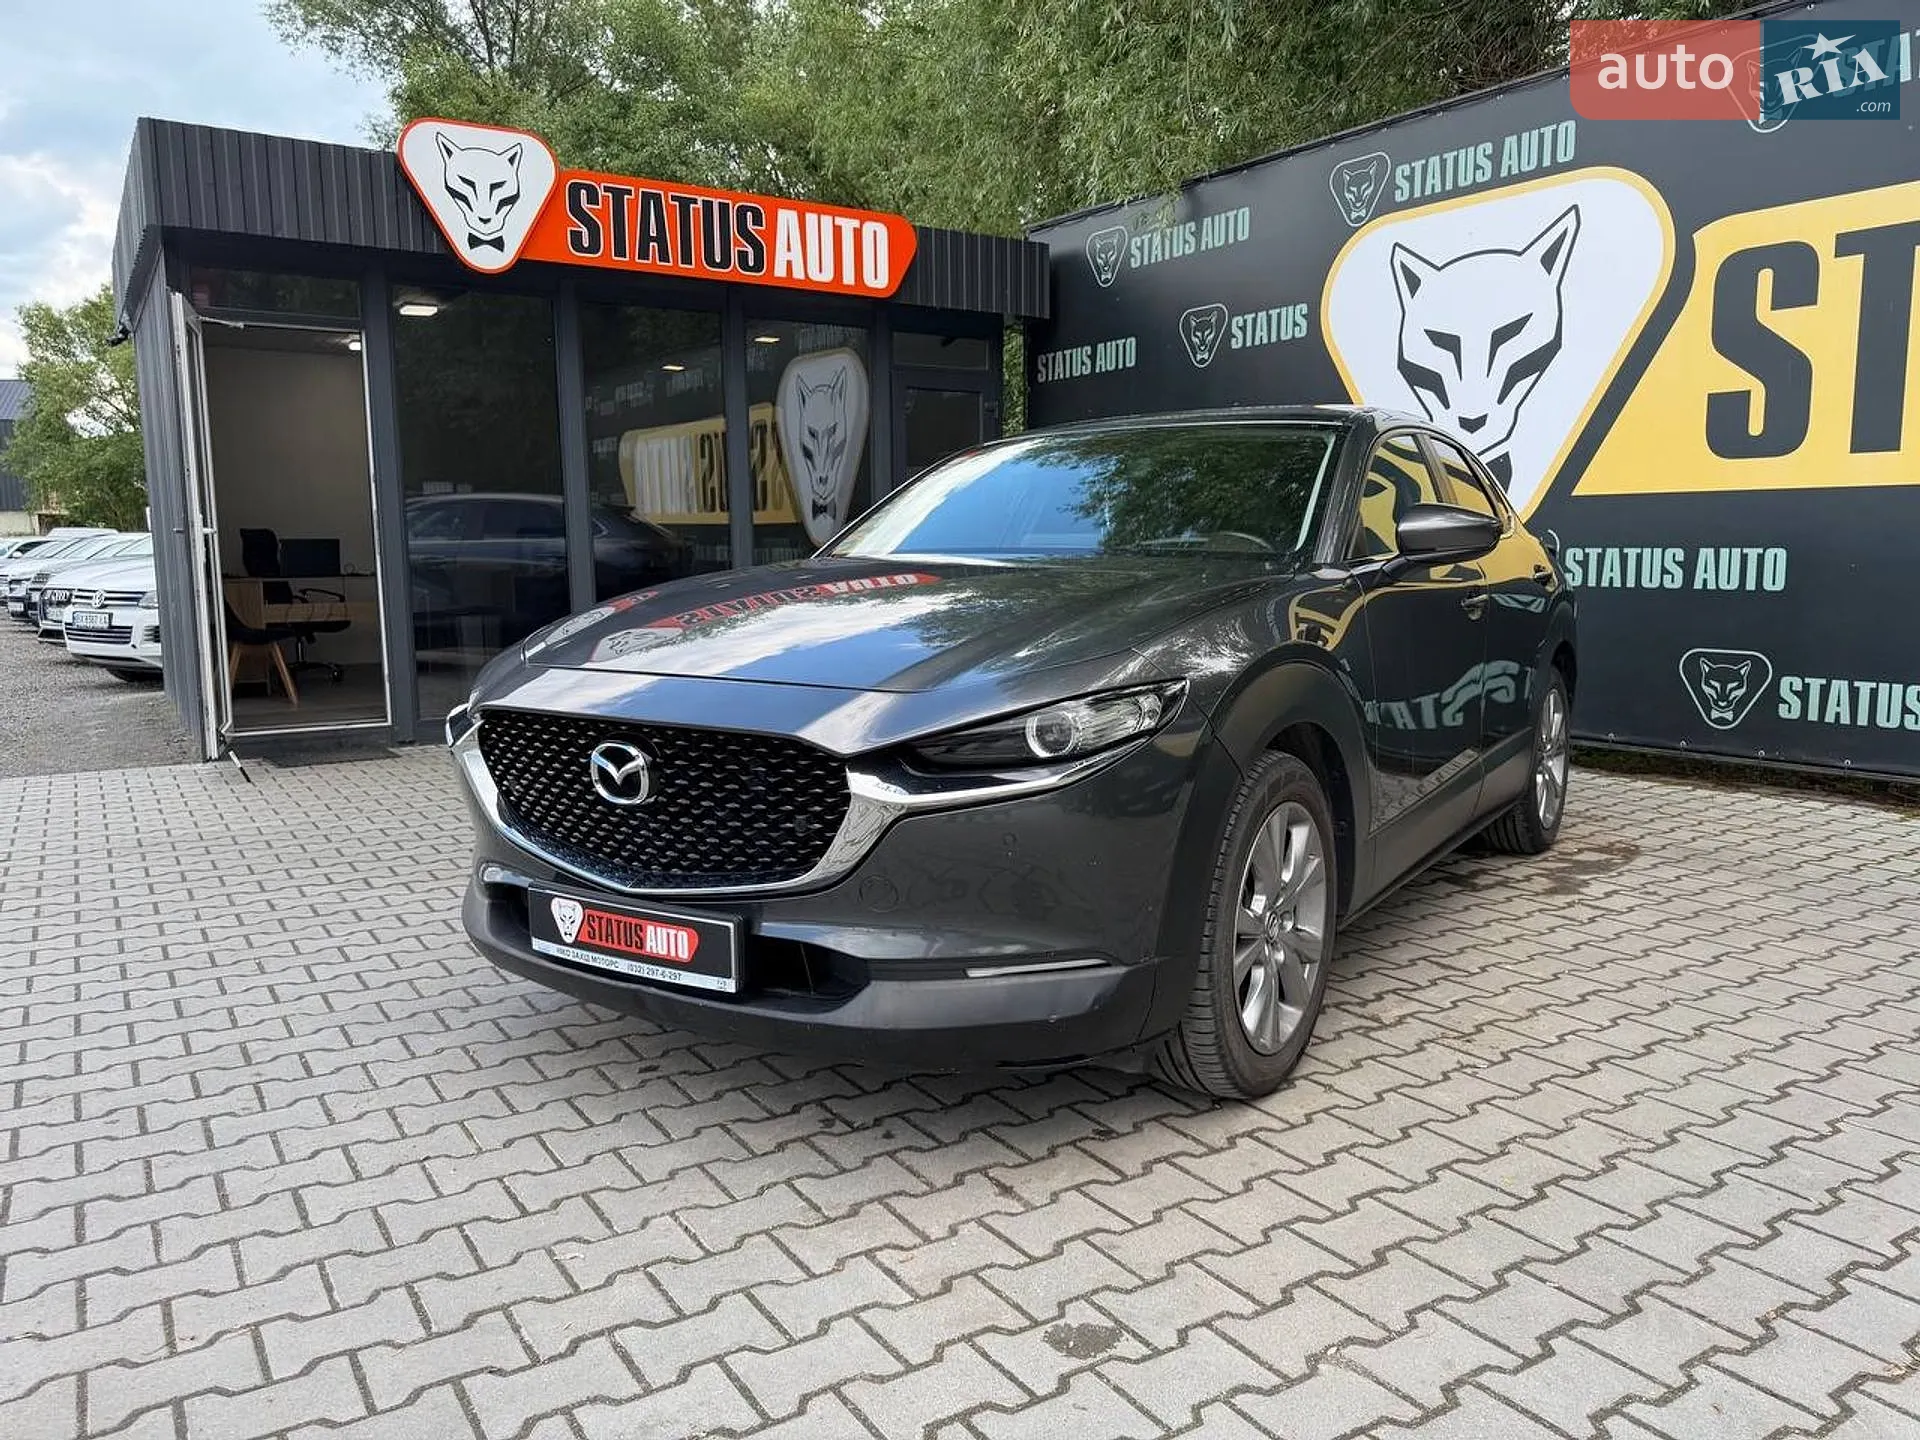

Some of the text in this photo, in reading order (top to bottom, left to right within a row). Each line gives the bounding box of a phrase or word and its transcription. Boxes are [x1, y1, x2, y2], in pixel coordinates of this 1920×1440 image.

[1394, 120, 1576, 203] STATUS AUTO
[566, 179, 889, 290] STATUS AUTO
[1130, 207, 1250, 269] STATUS AUTO
[1231, 303, 1308, 349] STATUS
[1037, 336, 1136, 383] STATUS AUTO
[1564, 548, 1787, 591] STATUS AUTO
[1778, 676, 1920, 732] STATUS
[587, 913, 689, 959] STATUS AUTO
